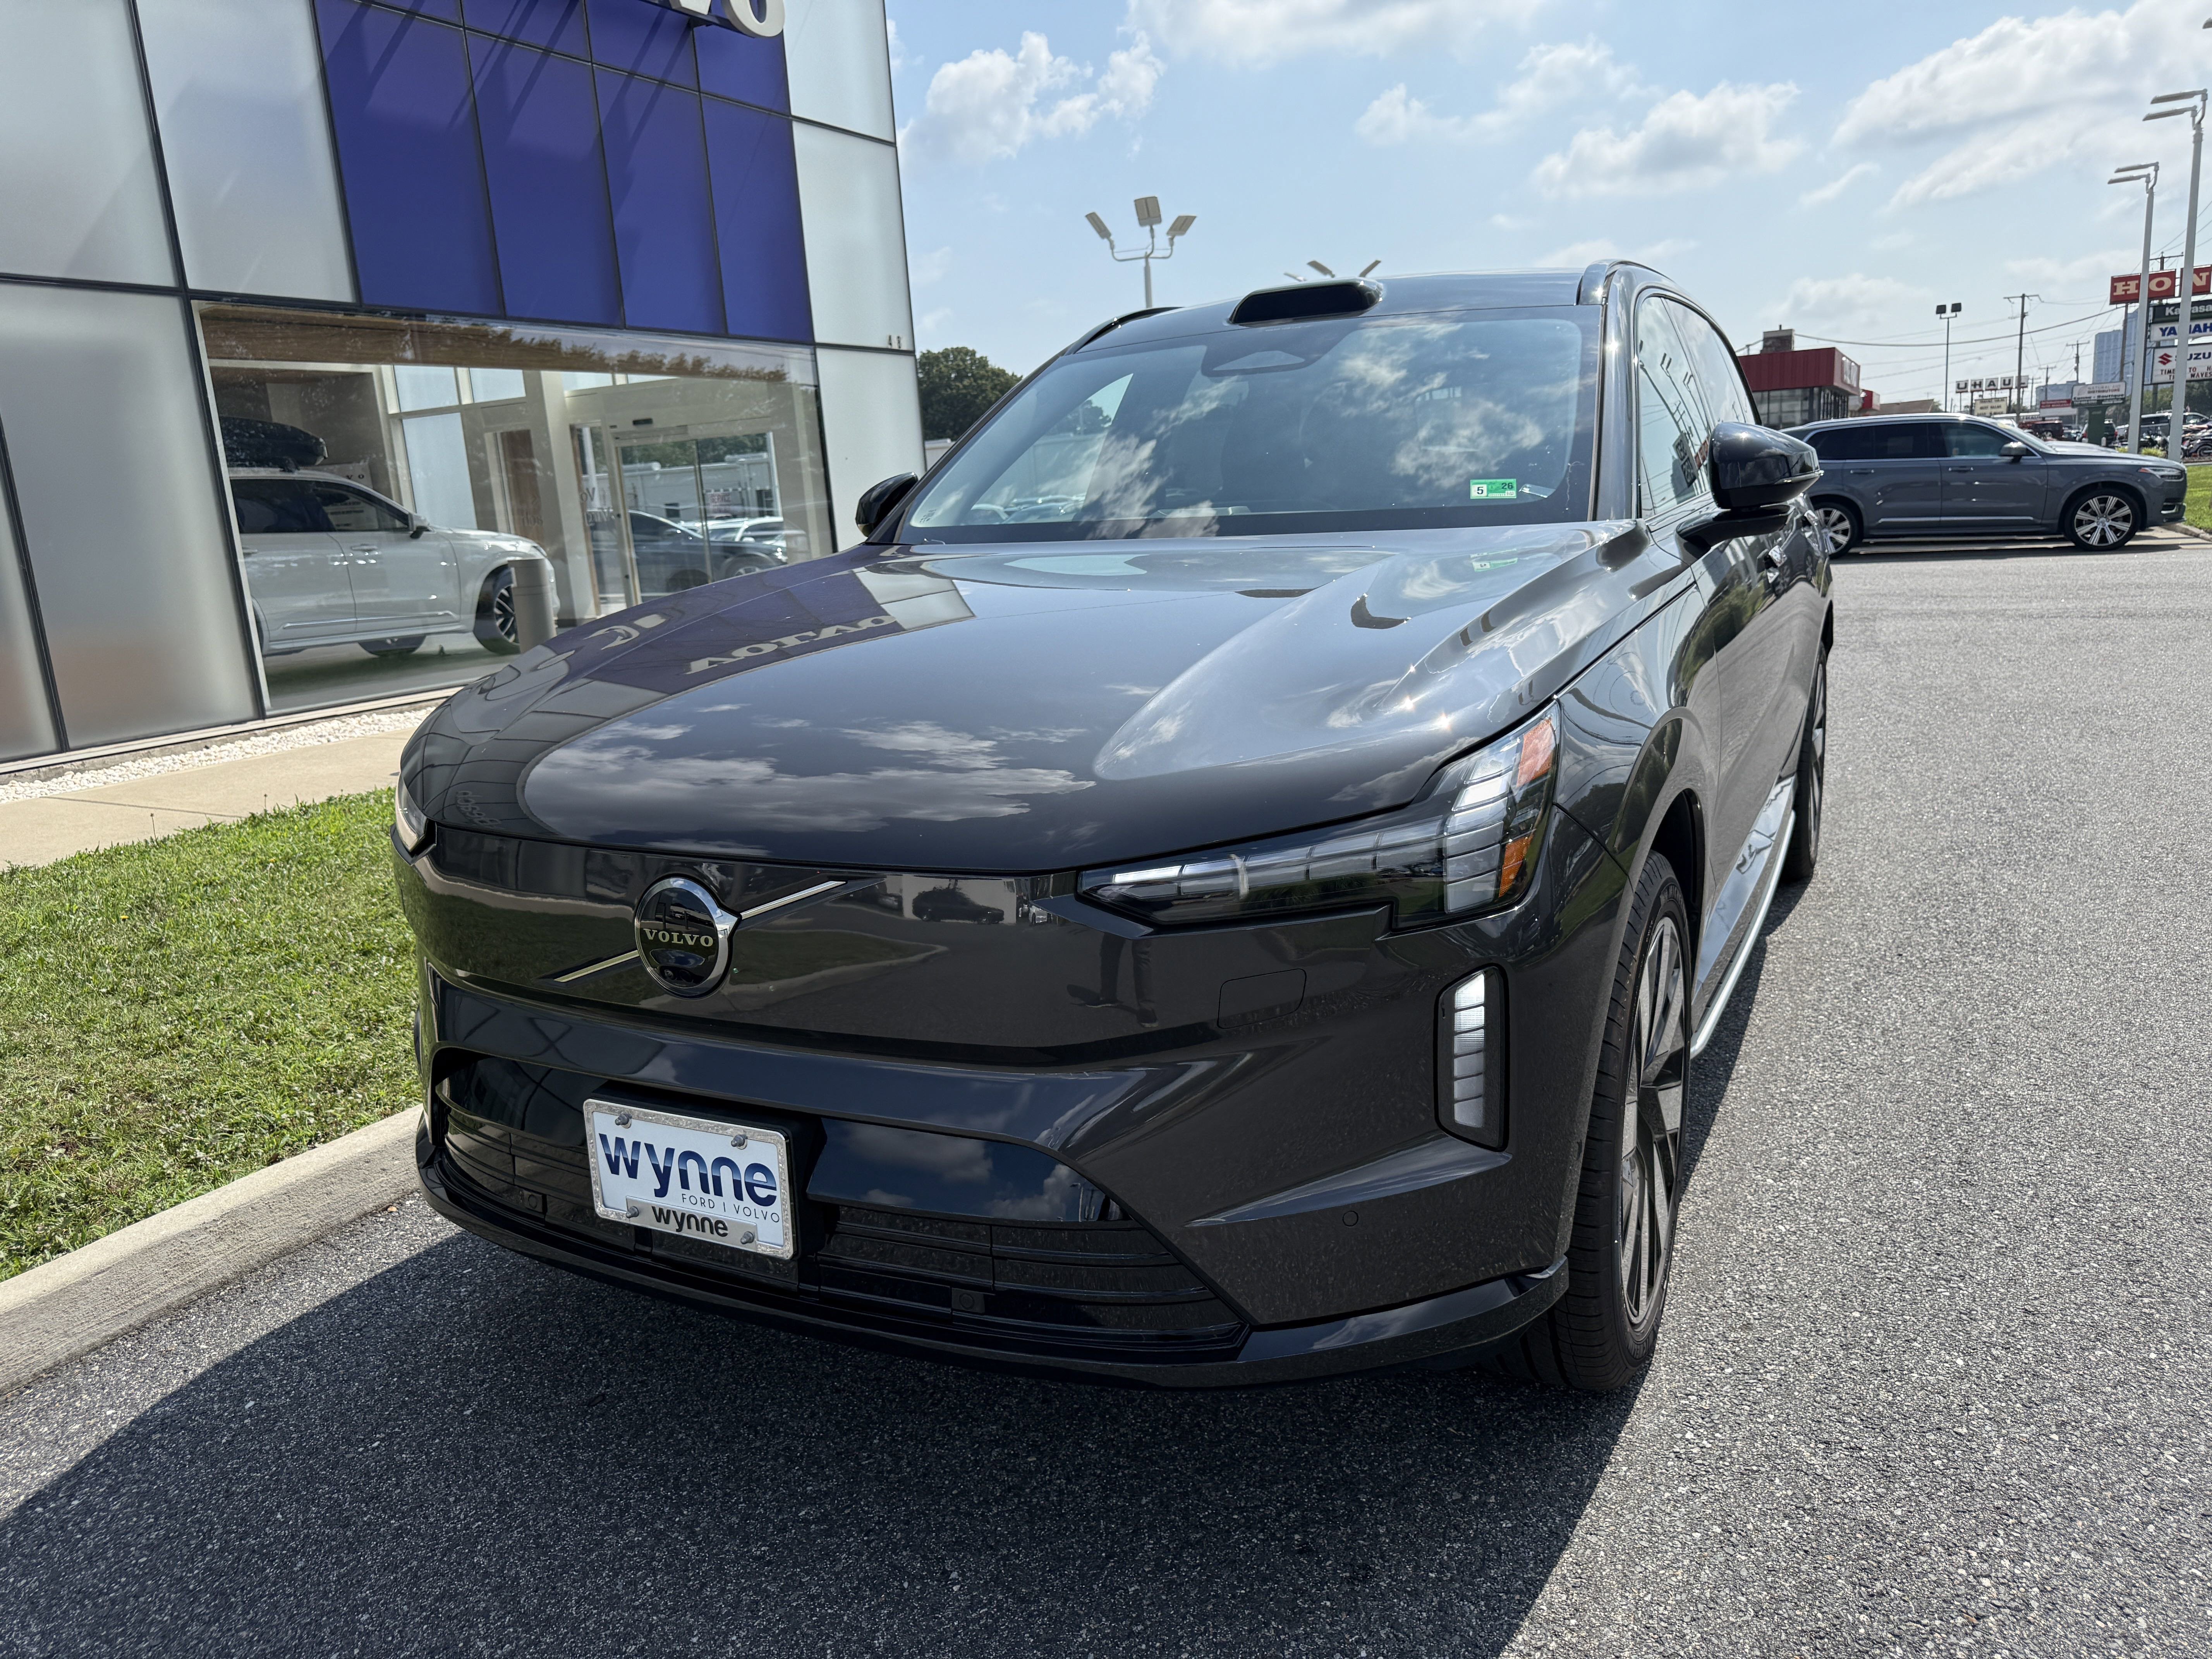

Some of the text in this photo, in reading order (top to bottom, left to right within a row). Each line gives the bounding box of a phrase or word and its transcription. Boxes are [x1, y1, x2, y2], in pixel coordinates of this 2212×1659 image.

[2165, 304, 2212, 316] Kaasa
[2159, 323, 2212, 337] YAAH
[2175, 352, 2211, 361] UZU
[643, 928, 713, 947] VOLVO
[599, 1133, 777, 1206] wynne
[682, 1193, 715, 1209] FORD
[733, 1204, 780, 1223] VOLVO
[651, 1206, 728, 1237] wynne
